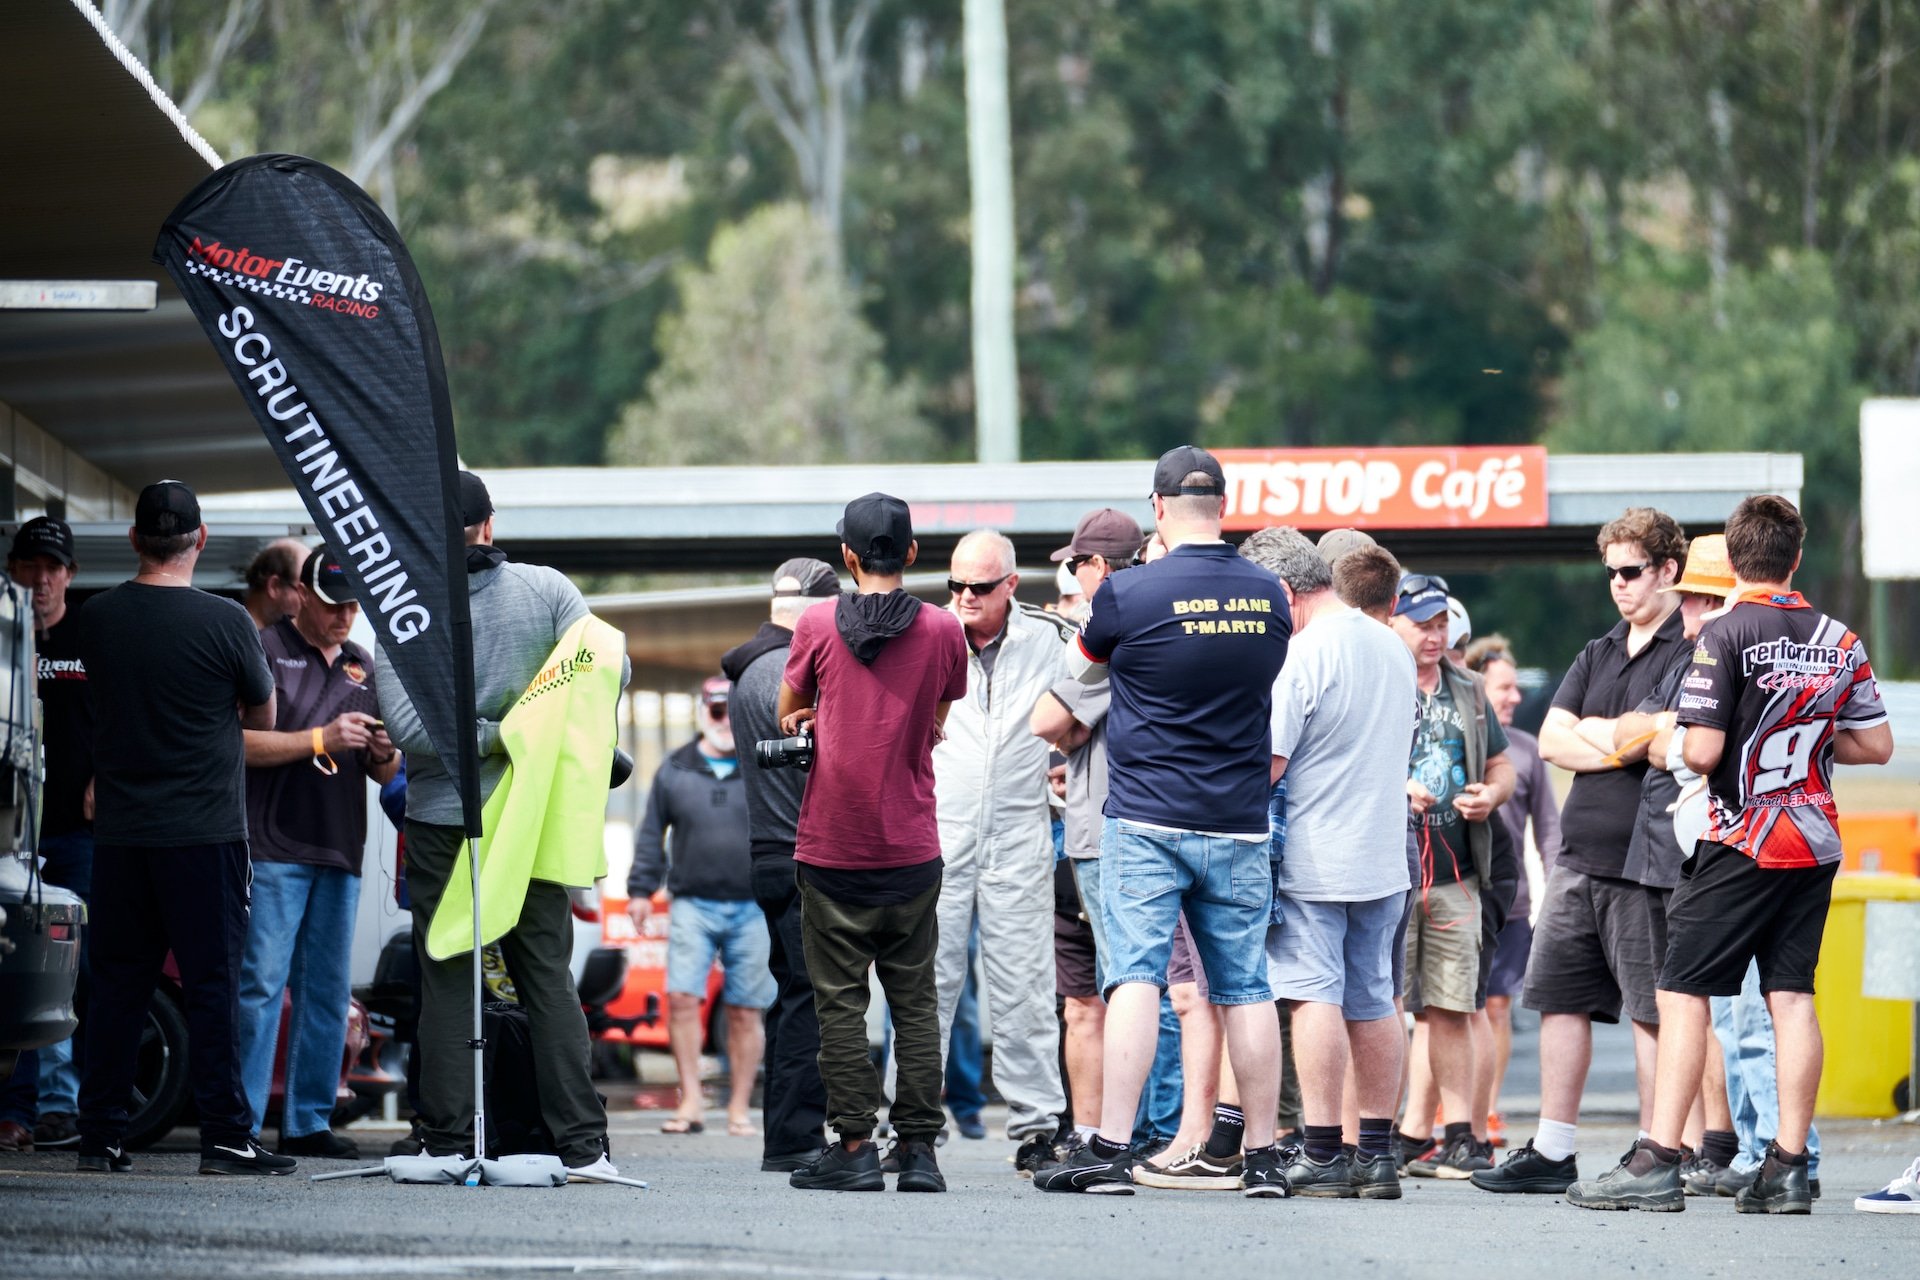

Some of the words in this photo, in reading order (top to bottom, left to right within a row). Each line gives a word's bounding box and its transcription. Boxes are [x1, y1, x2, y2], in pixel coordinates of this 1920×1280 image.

[188, 237, 383, 303] MotorEvents
[310, 293, 380, 319] RACING
[218, 305, 431, 644] SCRUTINEERING
[1221, 460, 1401, 516] ITSTOP
[1410, 454, 1526, 520] Café
[1173, 599, 1219, 615] BOB
[1223, 598, 1272, 613] JANE
[1182, 620, 1267, 635] T-MARTS
[1742, 636, 1857, 677] performax
[1756, 670, 1838, 698] Racing
[1752, 717, 1831, 795] 9
